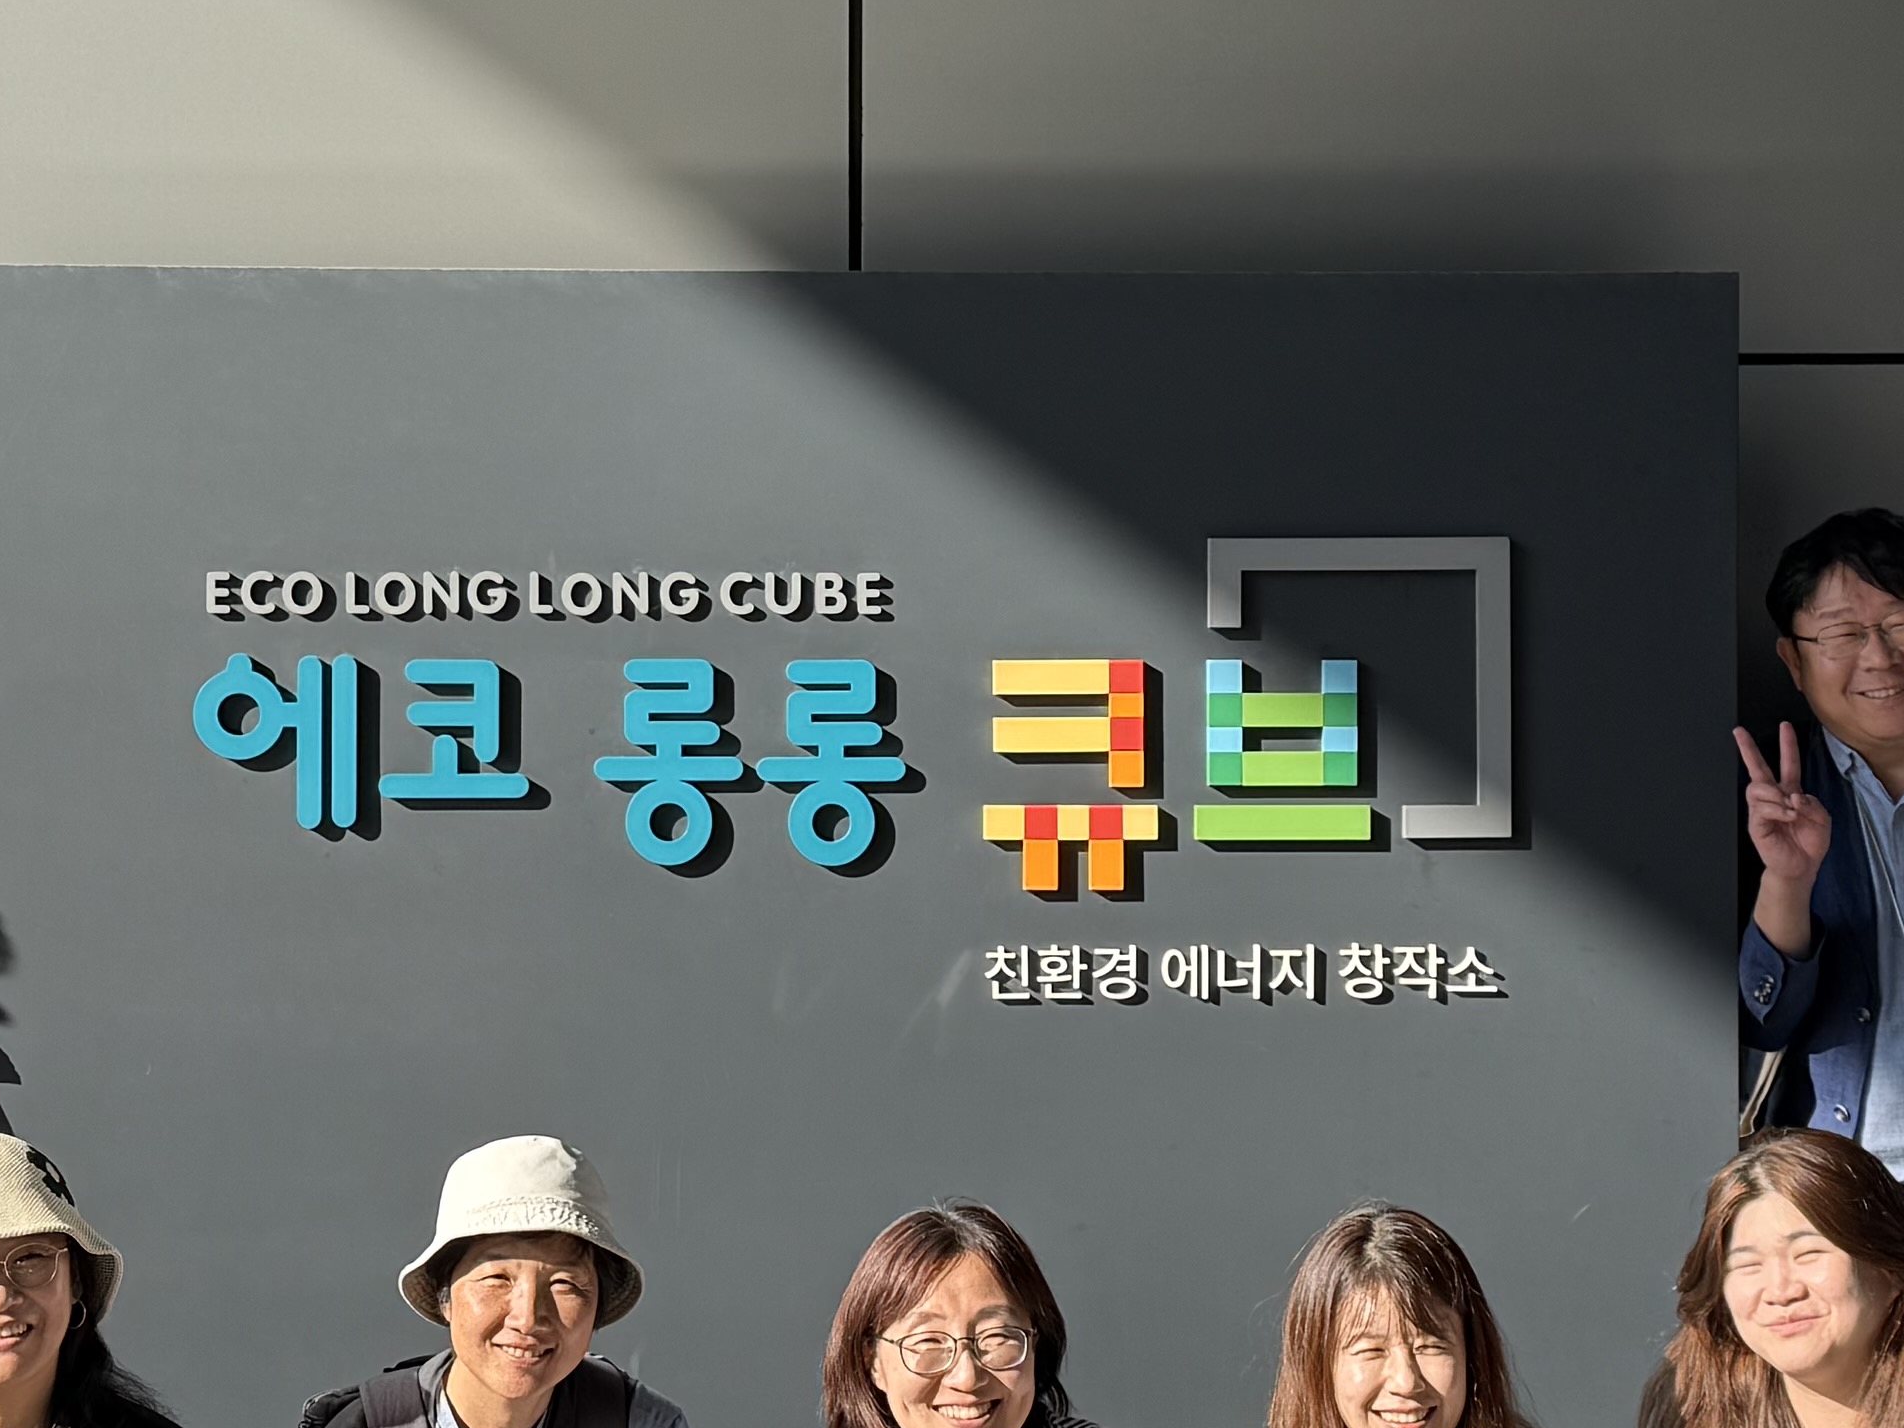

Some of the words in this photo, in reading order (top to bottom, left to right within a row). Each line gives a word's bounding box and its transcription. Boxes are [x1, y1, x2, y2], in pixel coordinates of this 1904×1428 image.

[205, 571, 324, 615] ECO
[345, 571, 508, 615] LONG
[529, 571, 700, 615] LONG
[719, 571, 882, 615] CUBE
[192, 652, 530, 830] 에코
[593, 658, 907, 866] 롱롱
[982, 658, 1372, 891] 큐브
[984, 943, 1138, 1001] 친환경
[1160, 943, 1315, 1001] 에너지
[1337, 941, 1499, 1001] 창작소
